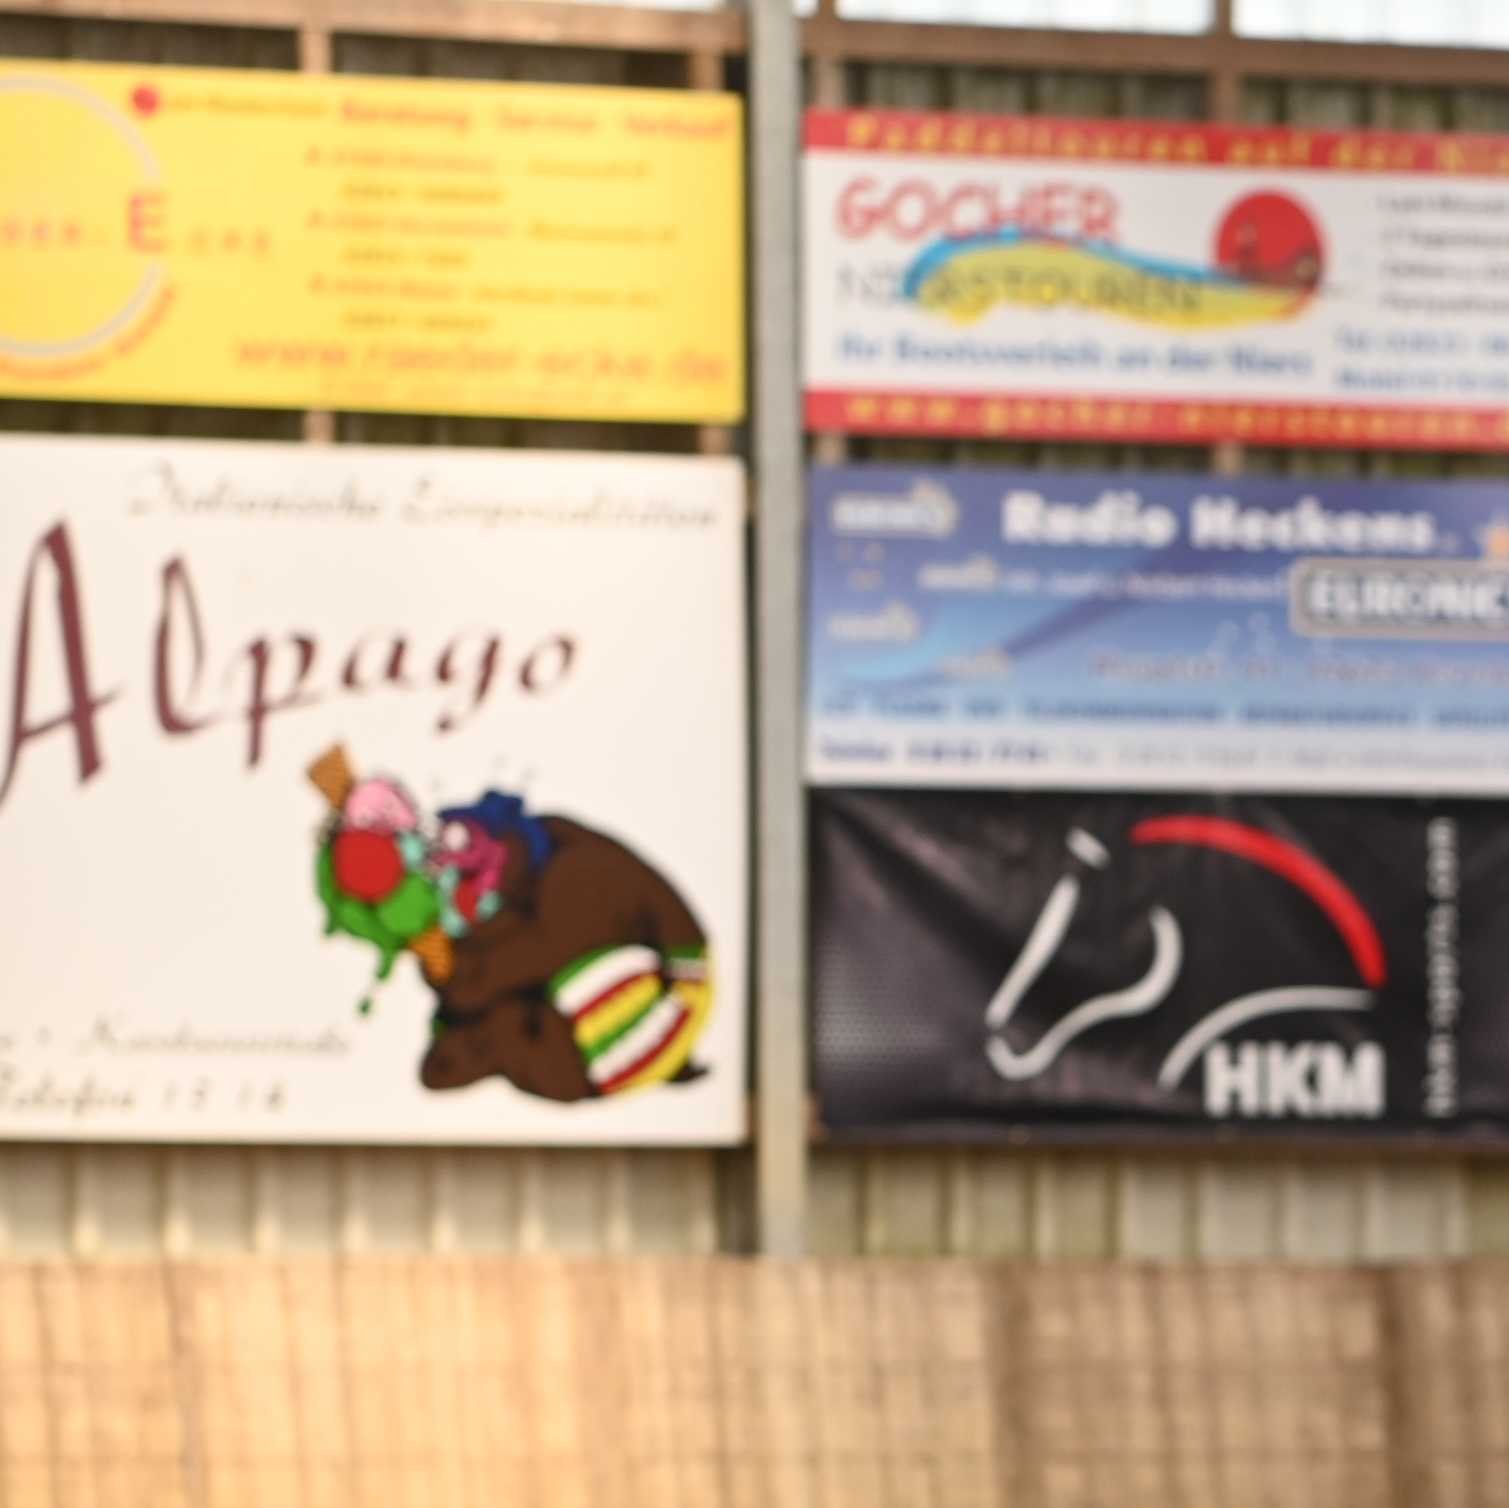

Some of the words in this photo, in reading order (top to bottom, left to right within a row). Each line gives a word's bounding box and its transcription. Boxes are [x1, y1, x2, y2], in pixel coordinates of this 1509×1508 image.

[1003, 489, 1178, 548] Radio
[0, 519, 578, 801] Alpago
[1204, 1040, 1386, 1118] HKM
